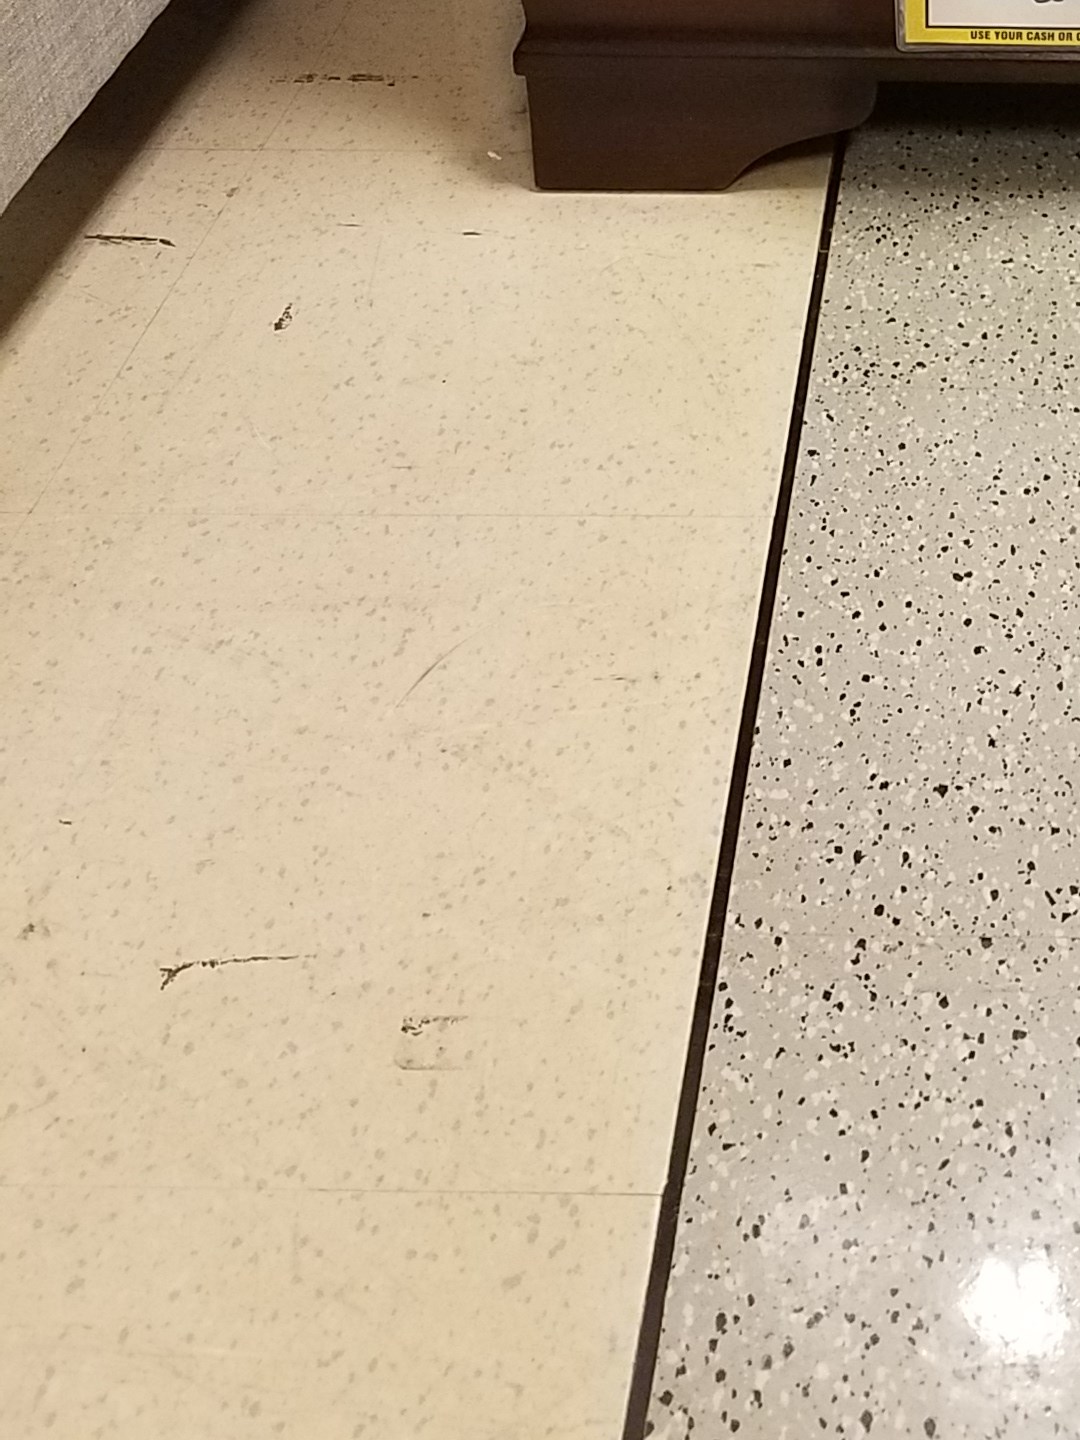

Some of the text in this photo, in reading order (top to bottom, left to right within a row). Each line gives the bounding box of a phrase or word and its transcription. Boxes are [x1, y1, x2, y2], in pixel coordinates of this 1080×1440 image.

[970, 30, 991, 40] USE
[994, 30, 1023, 41] YOUR
[1026, 31, 1054, 42] CASH
[1058, 33, 1073, 42] OR
